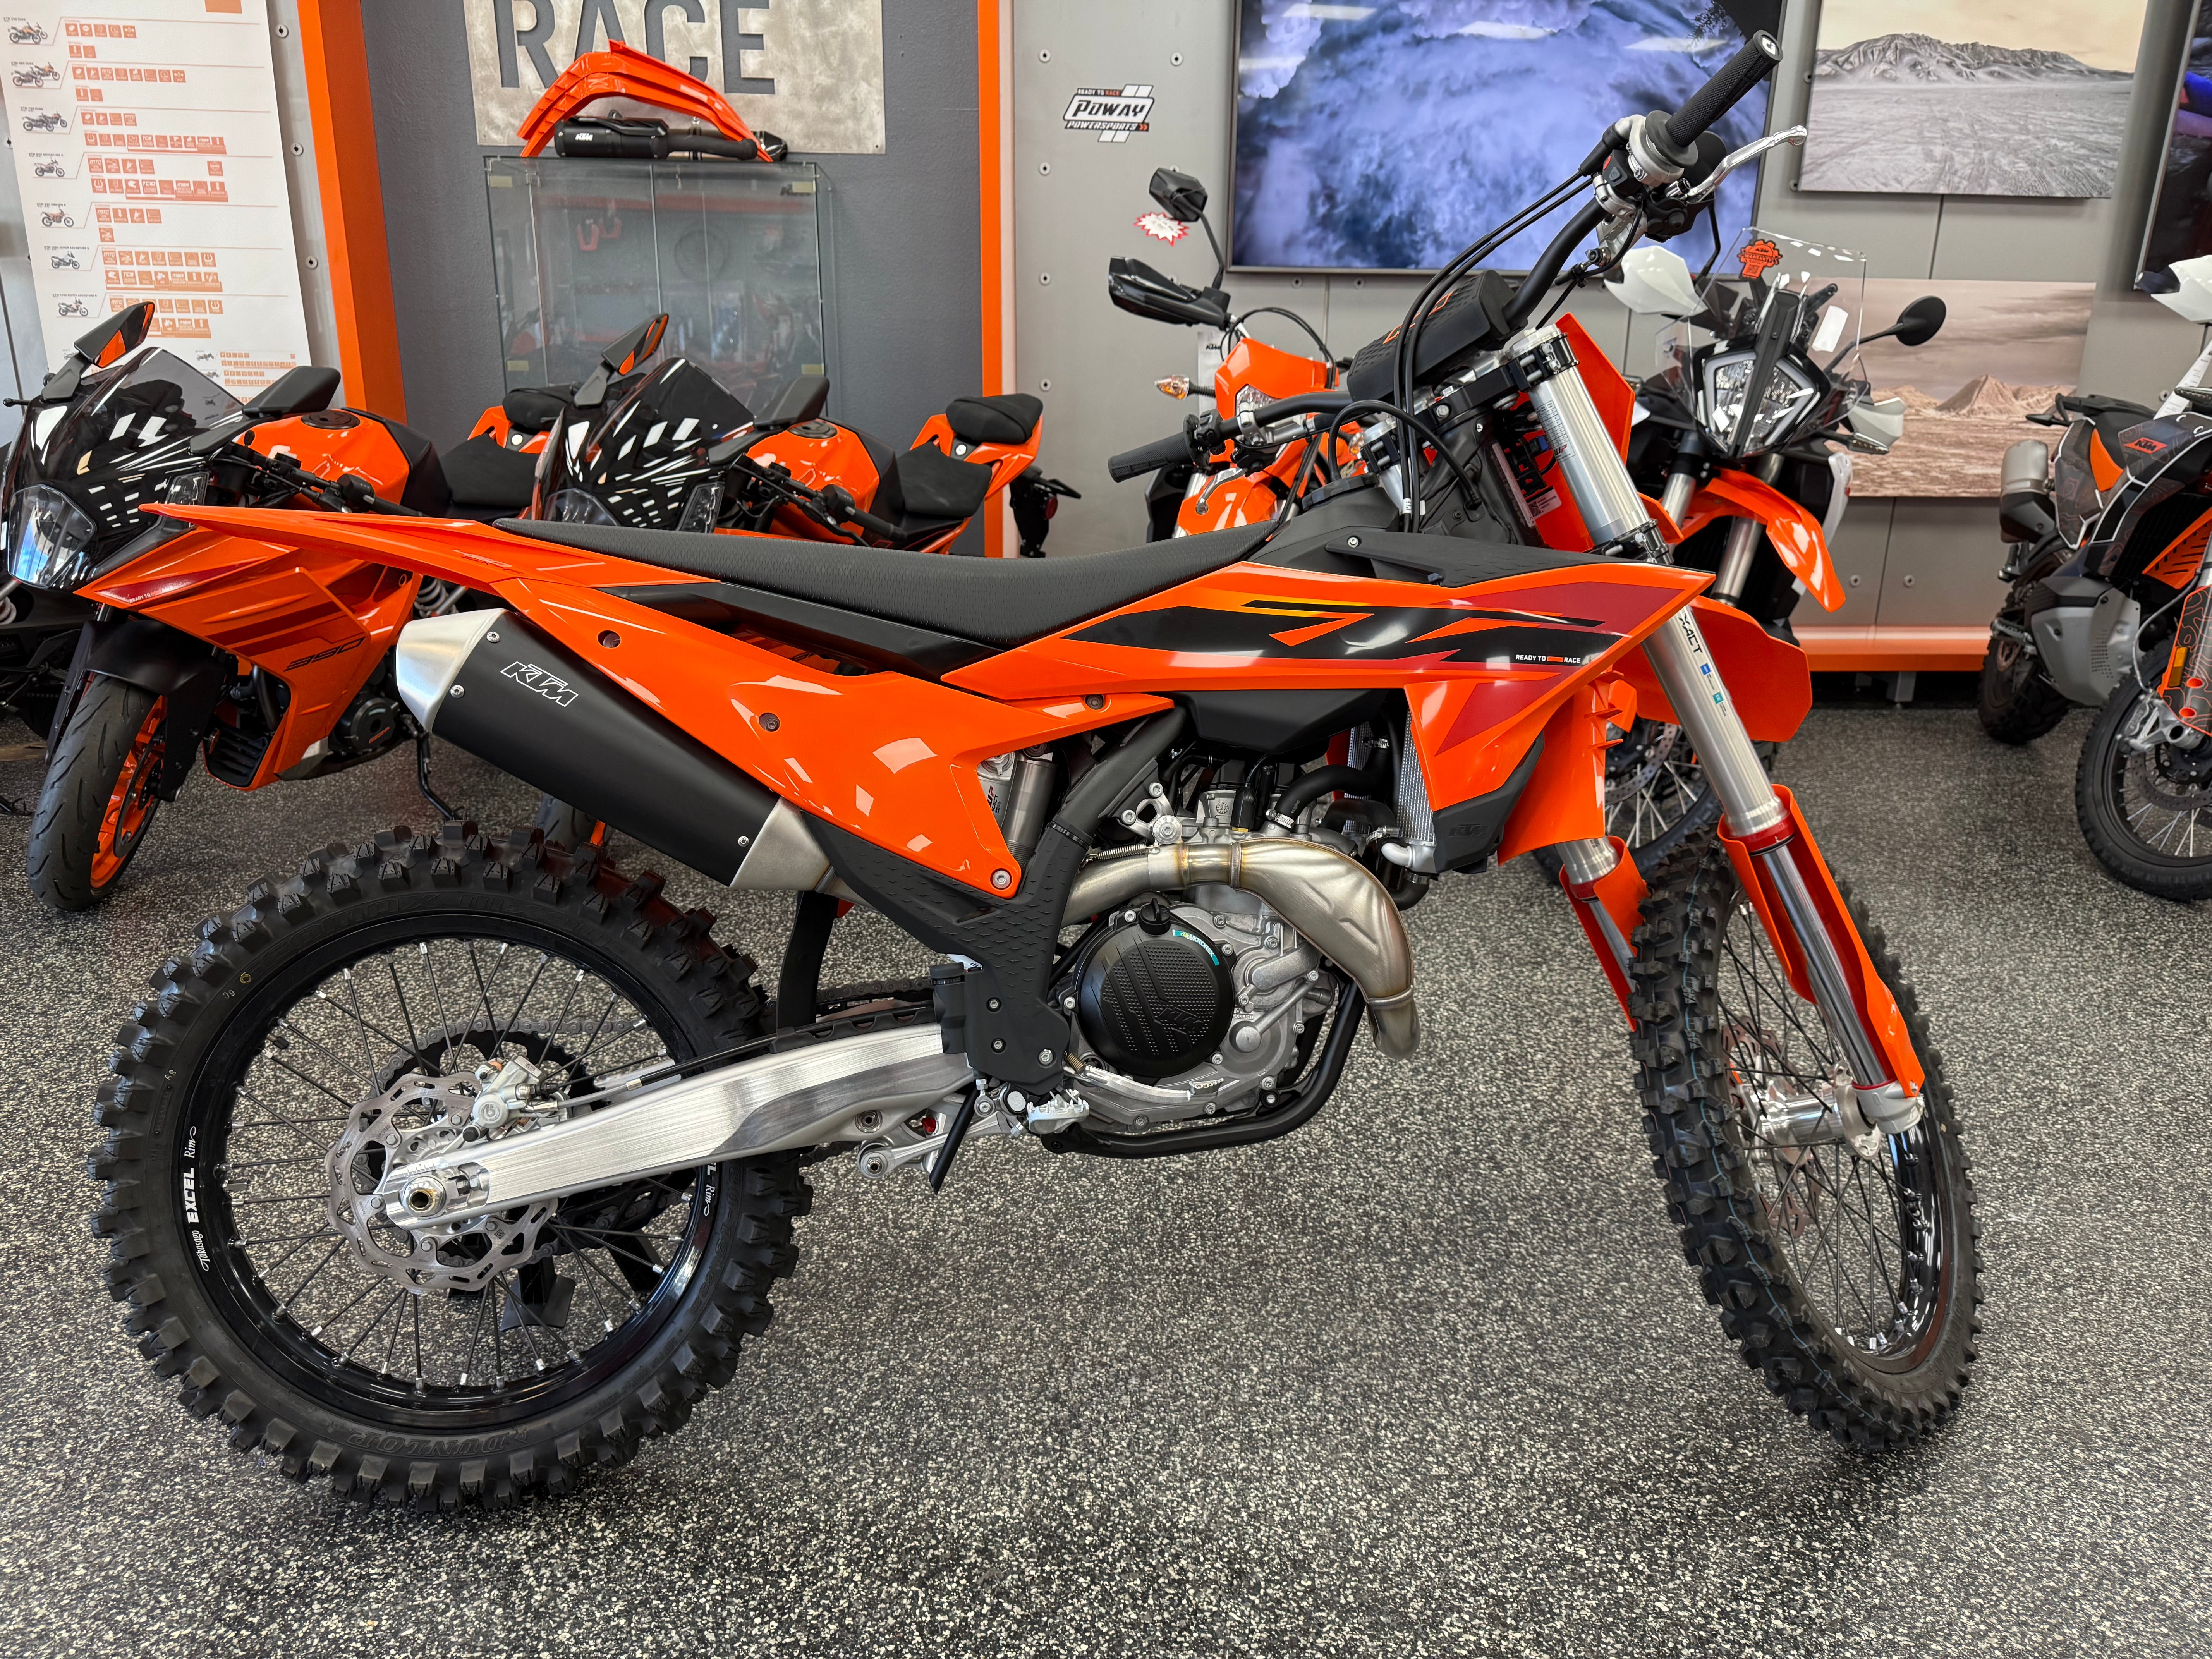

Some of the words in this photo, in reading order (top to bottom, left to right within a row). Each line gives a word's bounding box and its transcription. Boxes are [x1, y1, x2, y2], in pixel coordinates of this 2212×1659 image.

[575, 133, 593, 141] KTM
[1066, 121, 1139, 131] POWERSPORTS
[2135, 439, 2158, 451] KTM
[1678, 613, 1703, 653] XACT
[283, 635, 366, 672] 390
[500, 661, 579, 708] KTM
[1448, 823, 1489, 837] KTM
[1188, 934, 1215, 957] MOTOREX
[184, 1125, 197, 1159] Rim
[183, 1167, 199, 1224] EXCEL
[703, 1183, 716, 1217] Rim
[191, 1230, 210, 1272] Takasago
[347, 1431, 511, 1458] DUNLOP
